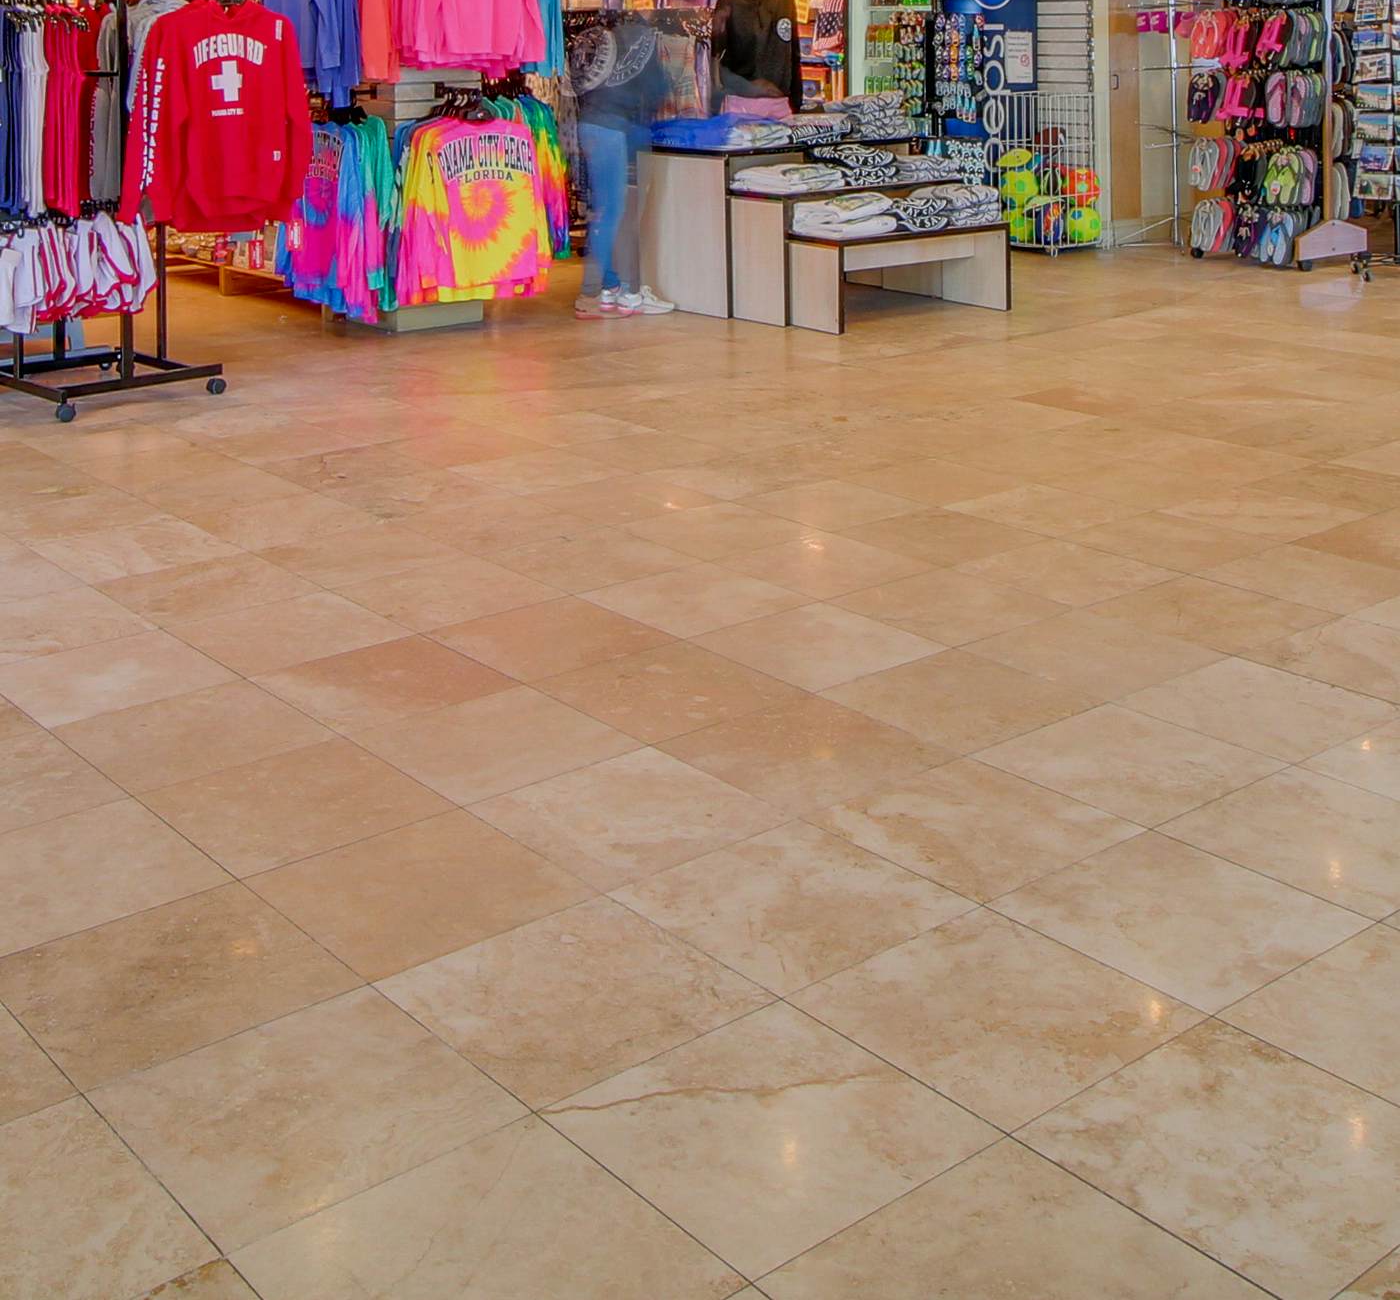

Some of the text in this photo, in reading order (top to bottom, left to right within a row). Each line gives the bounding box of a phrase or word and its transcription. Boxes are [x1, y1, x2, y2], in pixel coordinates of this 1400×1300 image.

[193, 33, 265, 69] LIFEGUARD
[478, 134, 500, 168] CITY
[503, 134, 535, 176] BEACH
